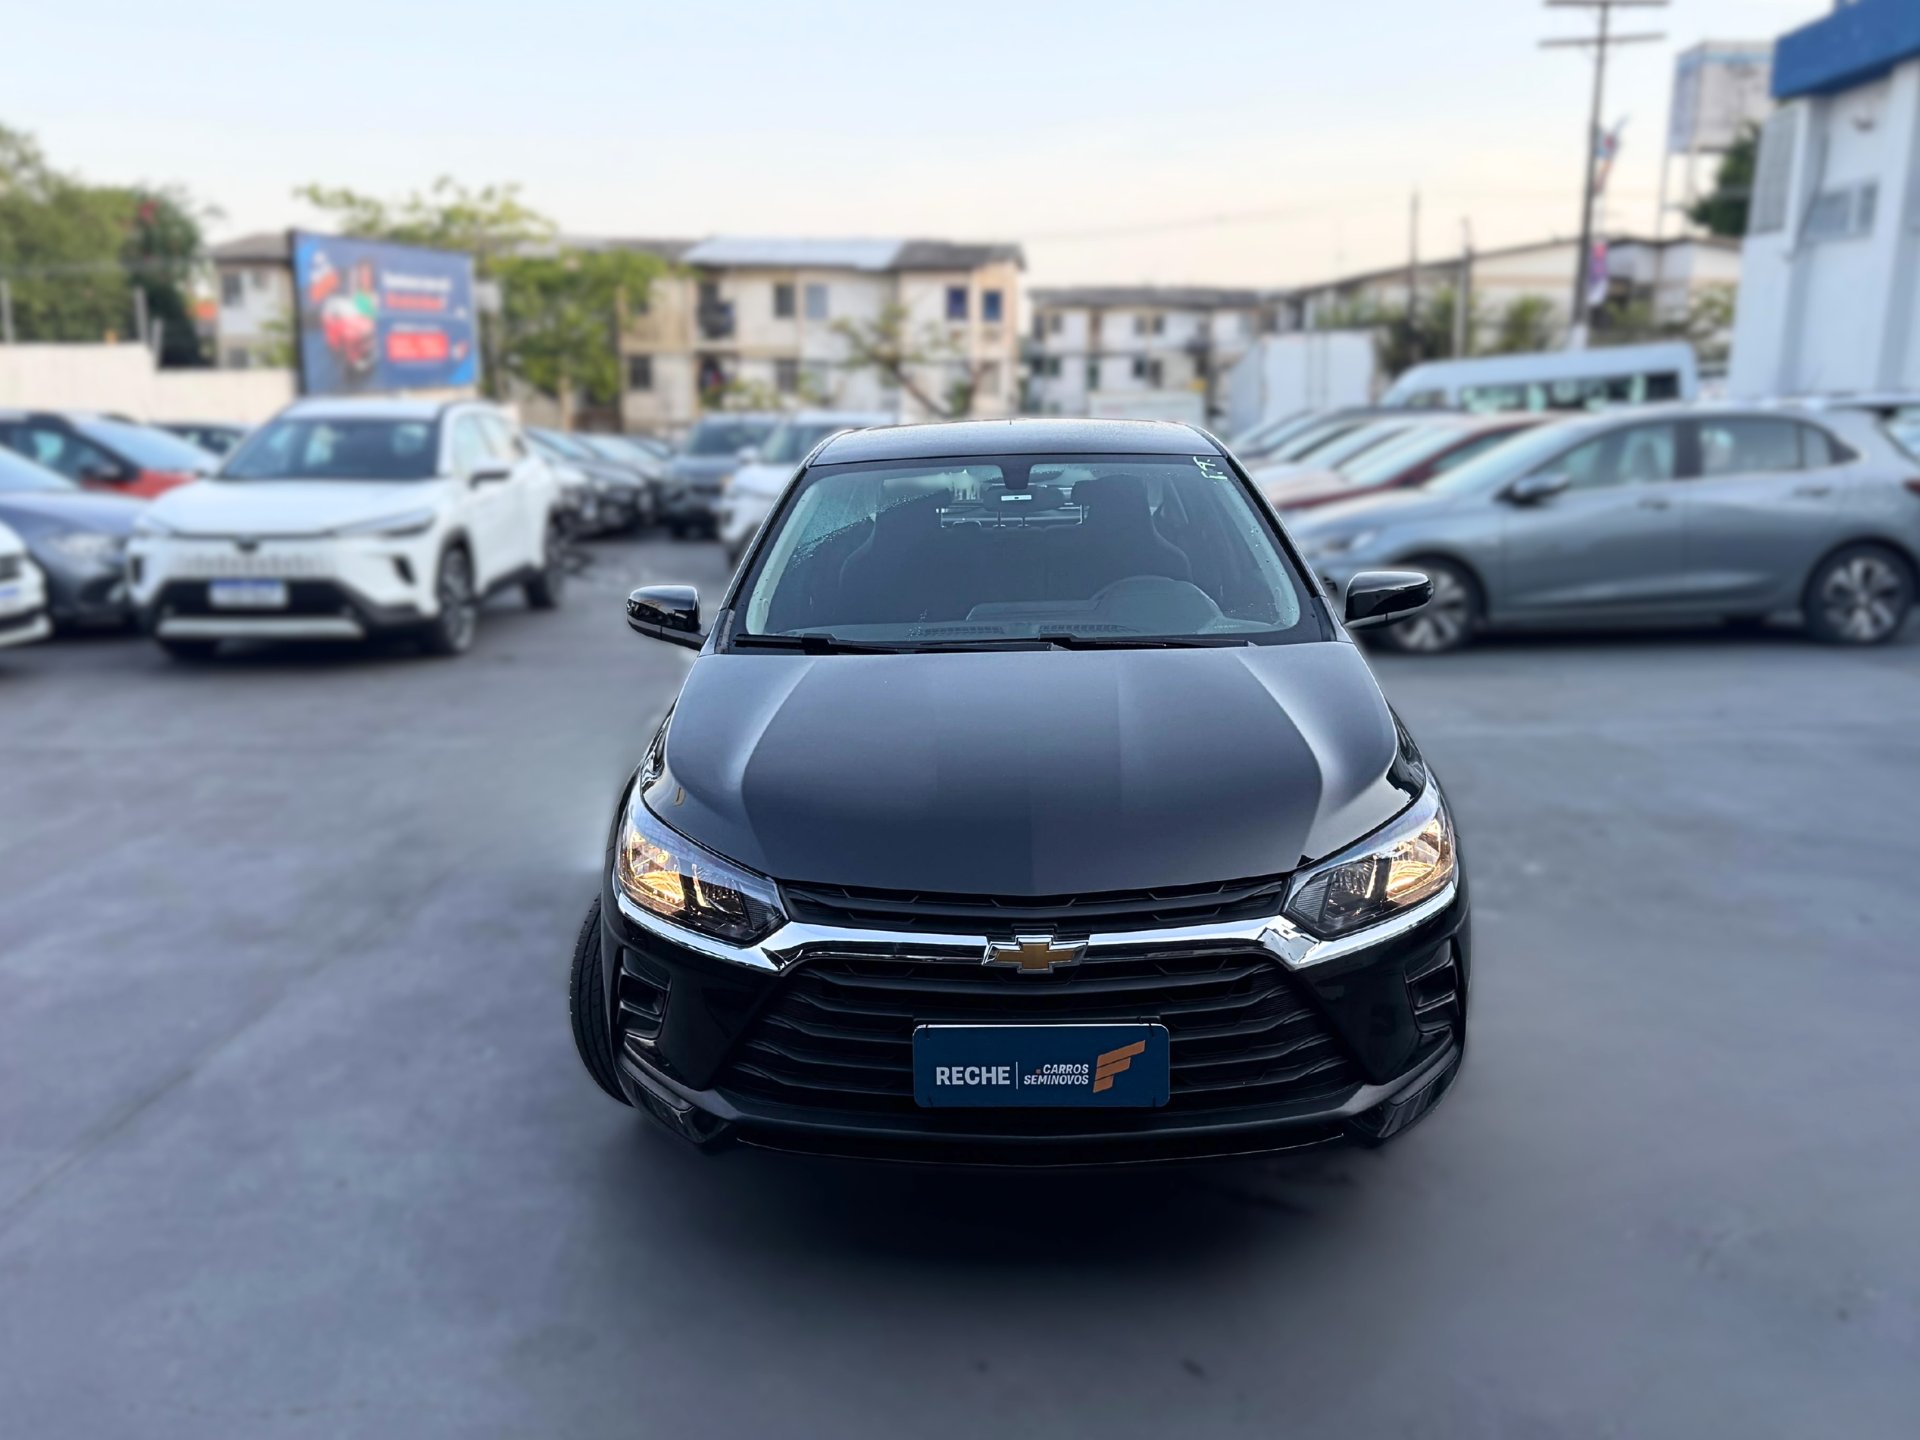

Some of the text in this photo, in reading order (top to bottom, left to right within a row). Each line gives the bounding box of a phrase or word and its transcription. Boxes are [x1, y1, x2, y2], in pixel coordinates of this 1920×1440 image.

[1043, 1064, 1089, 1074] CARROS
[936, 1066, 1010, 1085] RECHE
[1024, 1075, 1089, 1085] SEMINOVOS
